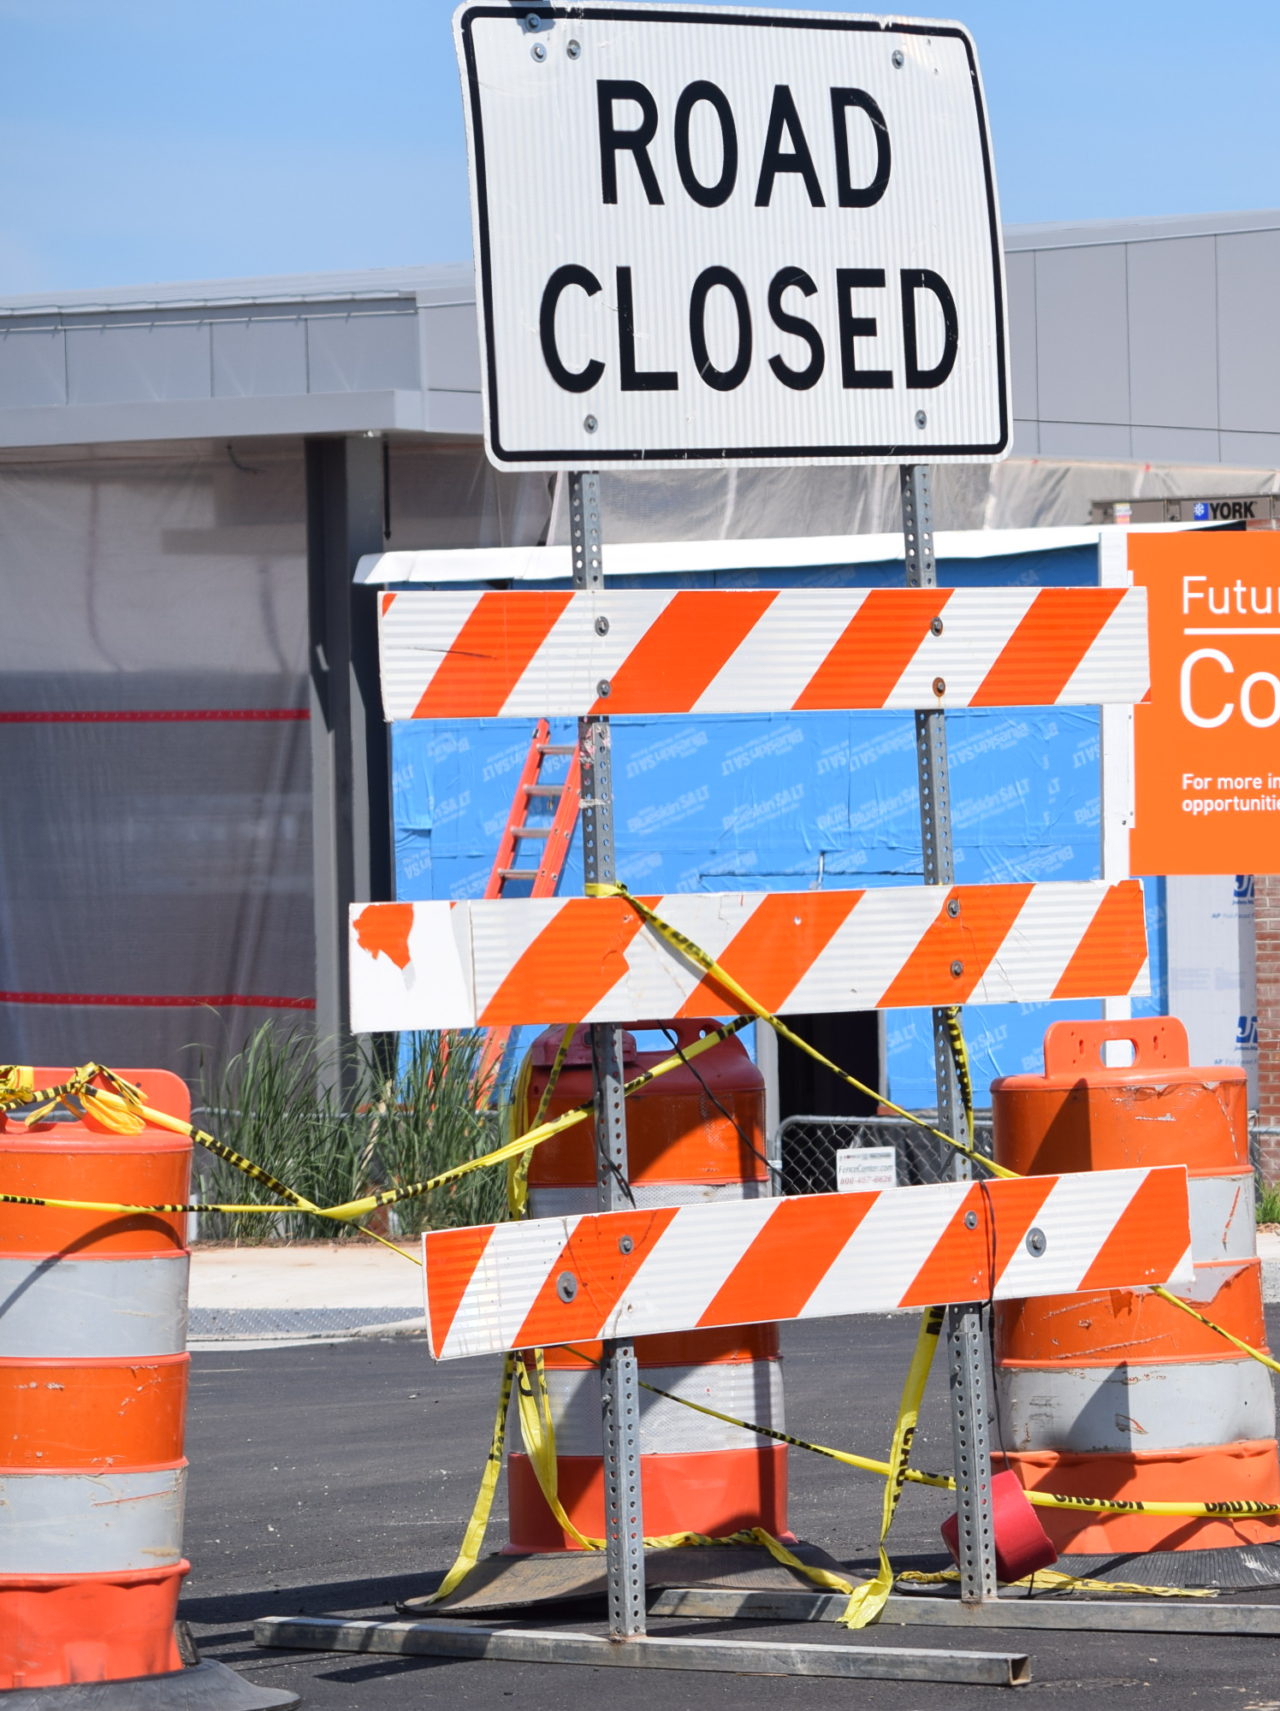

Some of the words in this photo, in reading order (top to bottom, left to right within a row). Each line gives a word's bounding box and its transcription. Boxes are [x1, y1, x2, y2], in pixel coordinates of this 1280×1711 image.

[597, 80, 892, 208] ROAD
[540, 264, 959, 393] CLOSED
[1210, 501, 1255, 519] YORK
[1182, 773, 1213, 790] For
[1217, 776, 1263, 790] more
